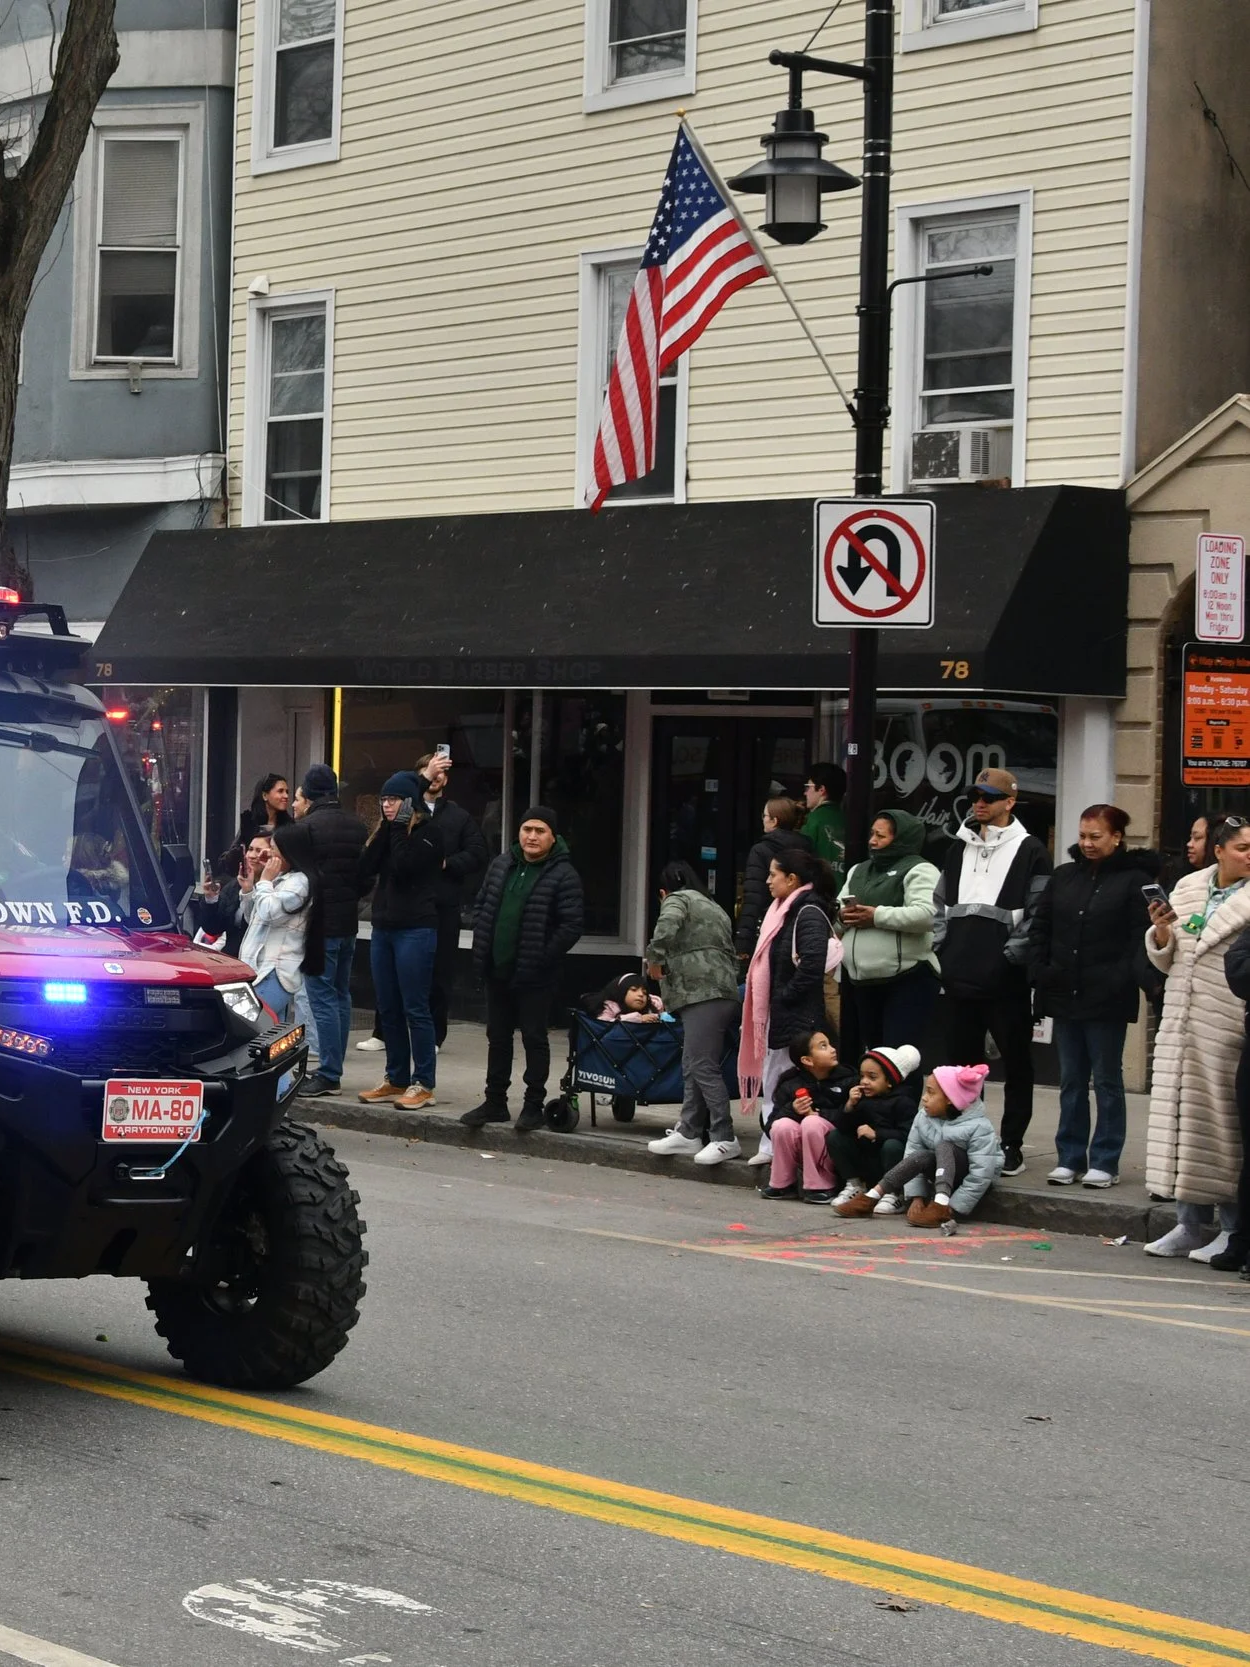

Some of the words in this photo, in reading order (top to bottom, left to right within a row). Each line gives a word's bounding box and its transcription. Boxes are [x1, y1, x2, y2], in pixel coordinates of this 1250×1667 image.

[1205, 541, 1237, 554] LOADING
[1210, 556, 1230, 569] ZONE
[1211, 572, 1229, 584] ONLY
[1204, 590, 1228, 599] 8:00am
[1230, 592, 1237, 600] to
[1208, 601, 1214, 610] 12
[1216, 602, 1232, 610] Noon
[1206, 612, 1218, 620] Mon
[1221, 613, 1234, 621] thru
[1210, 622, 1229, 632] Friday
[96, 663, 112, 677] 78
[439, 658, 526, 681] BARBER
[535, 660, 600, 681] SHOP
[940, 660, 969, 679] 78
[1189, 685, 1214, 695] Monday
[1219, 686, 1248, 696] Saturday
[64, 902, 122, 924] F.D.
[132, 1100, 194, 1120] MA-80
